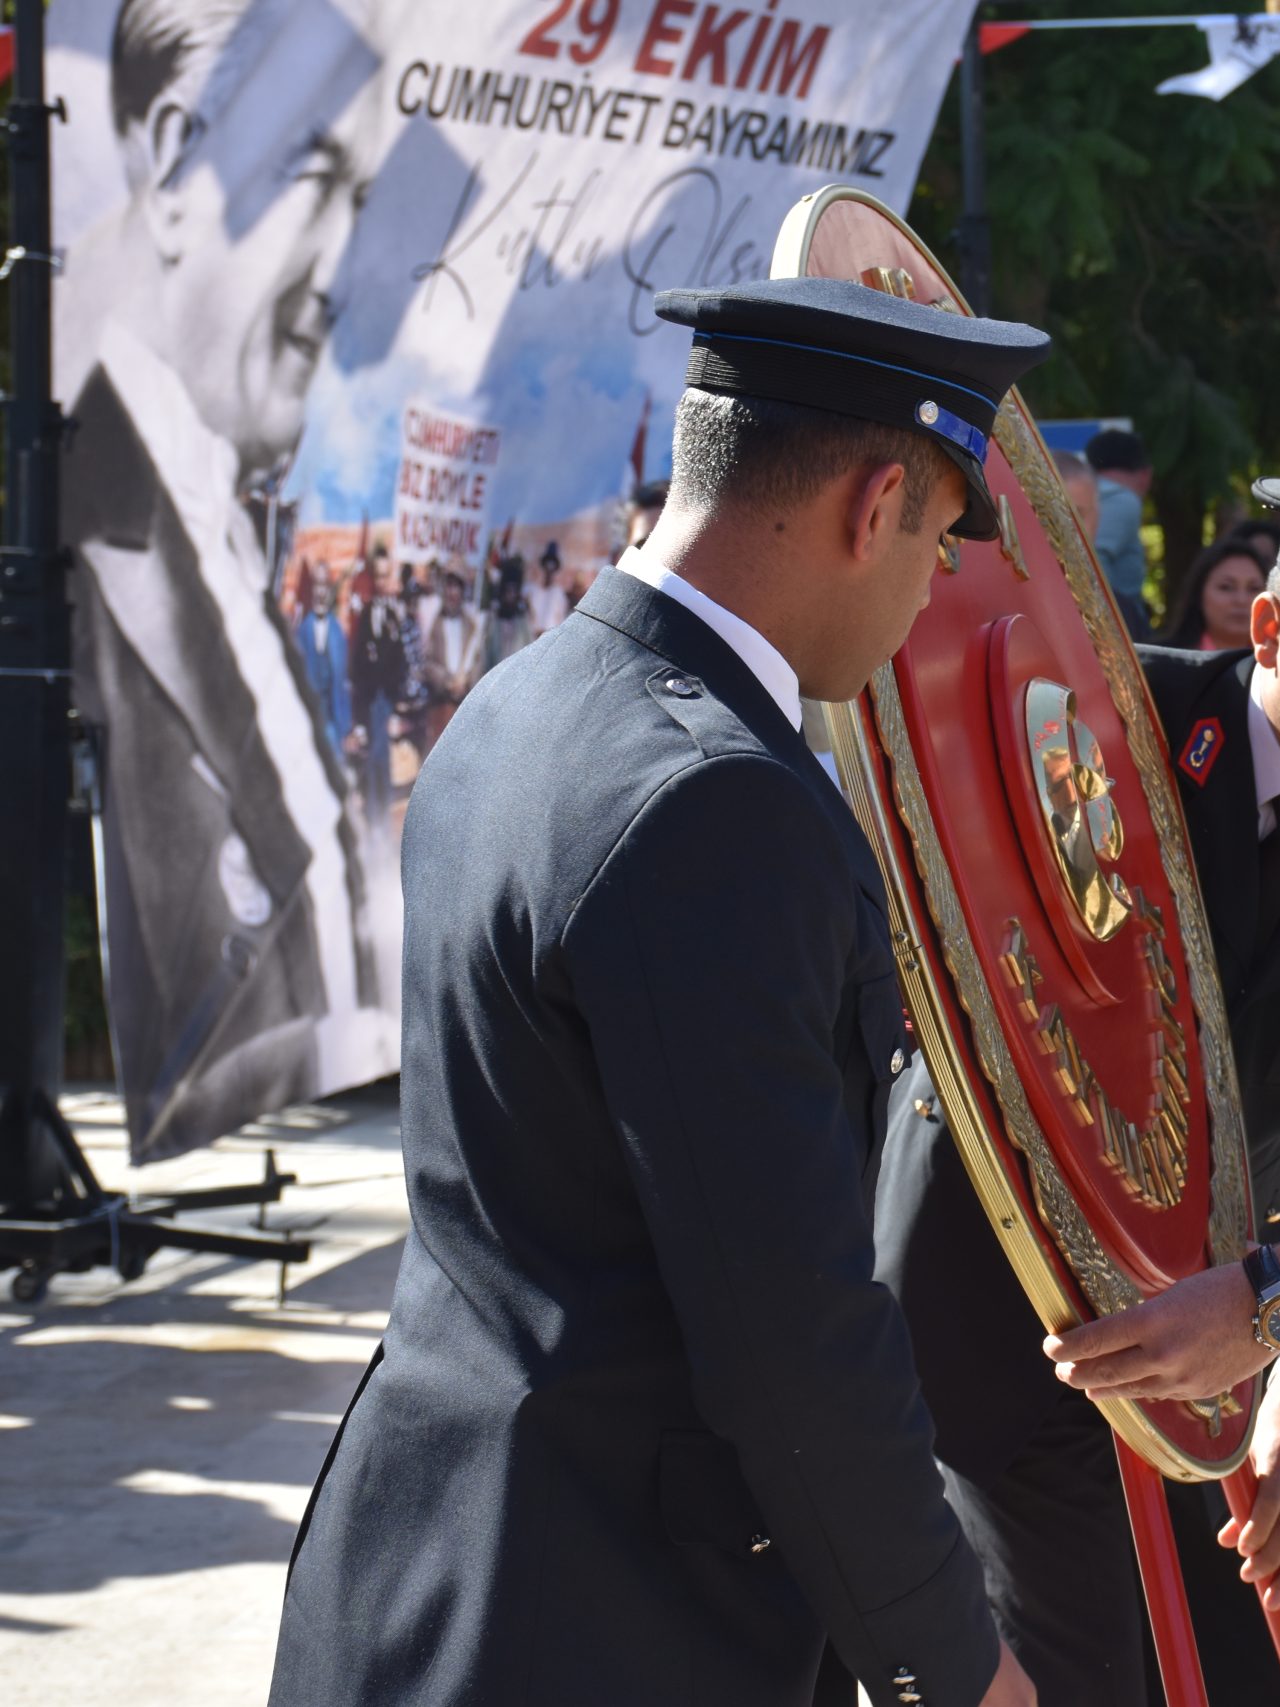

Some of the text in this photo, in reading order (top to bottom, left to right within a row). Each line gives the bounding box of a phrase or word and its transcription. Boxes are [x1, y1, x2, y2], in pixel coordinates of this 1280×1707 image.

[518, 0, 831, 99] 29 EKİM
[396, 60, 899, 179] CUMHURİYET BAYRAMIMIZ
